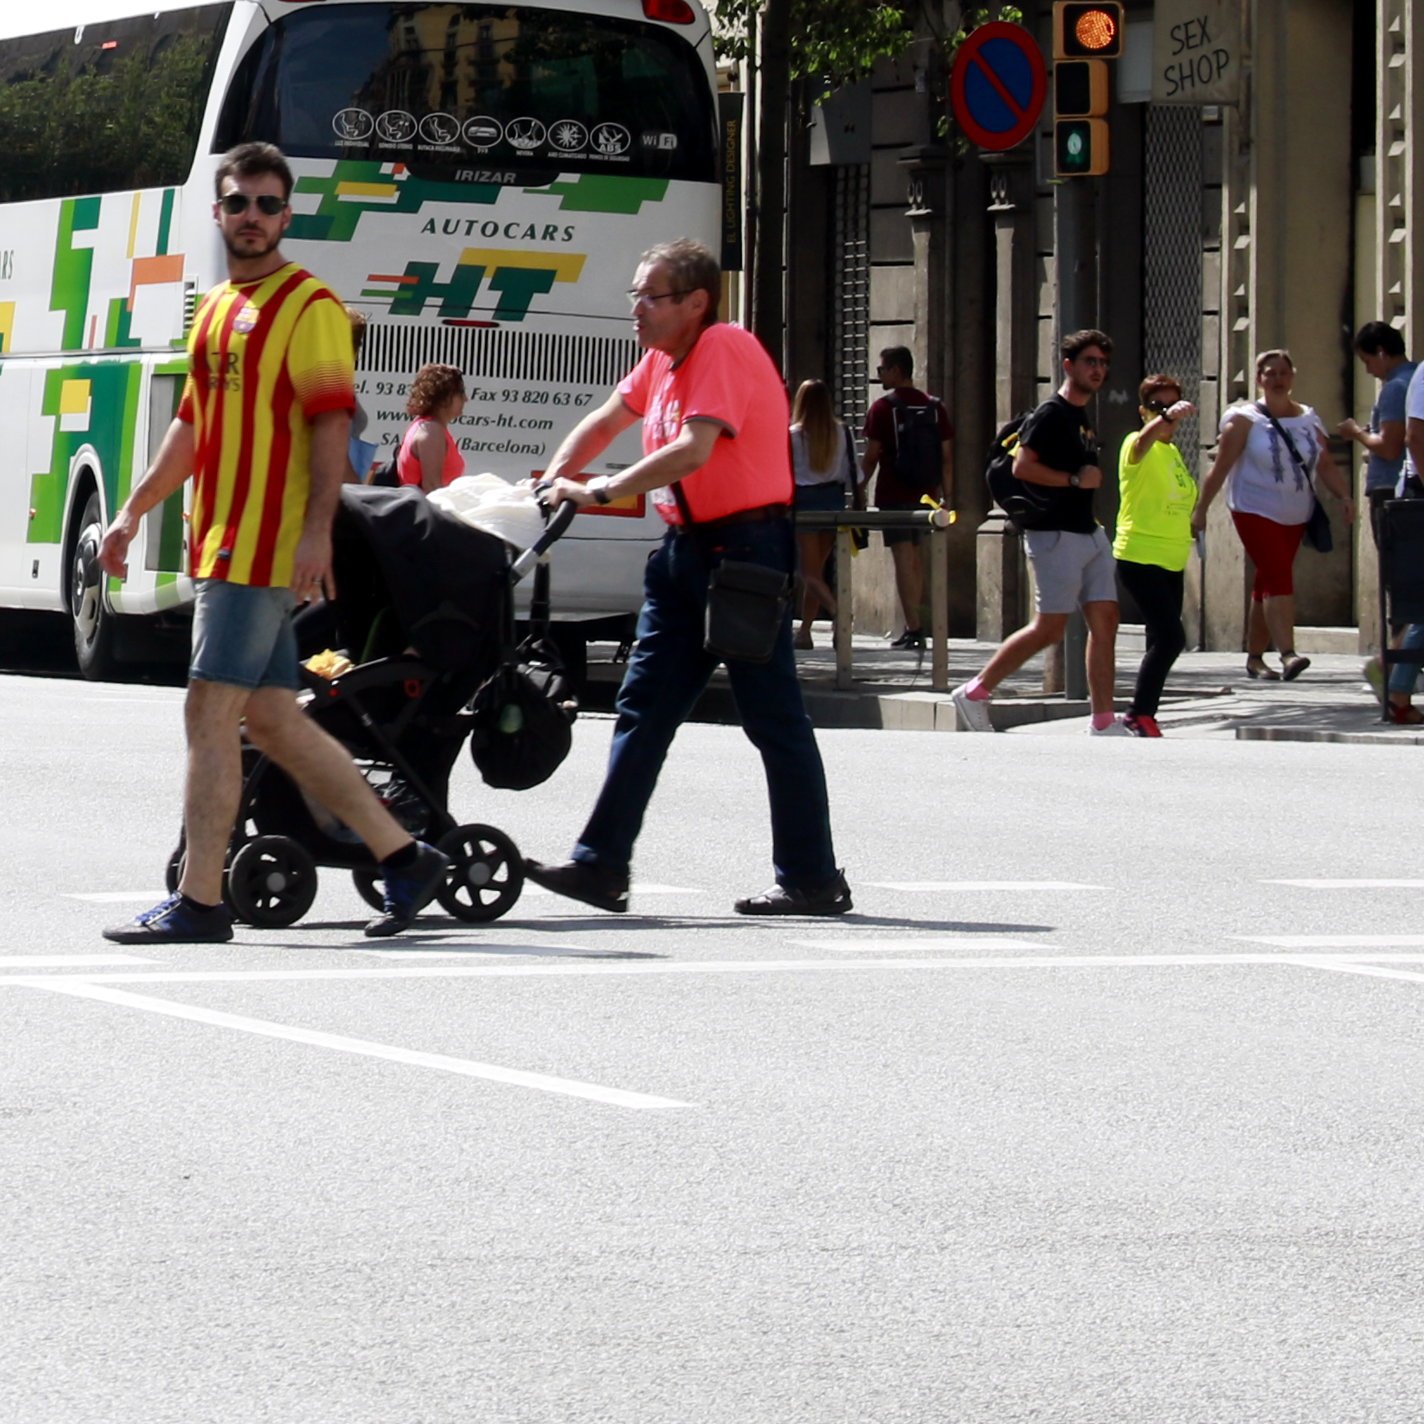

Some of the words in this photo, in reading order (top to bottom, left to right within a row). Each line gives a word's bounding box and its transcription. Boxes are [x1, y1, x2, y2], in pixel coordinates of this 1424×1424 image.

[1170, 15, 1212, 56] SEX
[1163, 48, 1230, 97] SHOP
[598, 143, 622, 153] ABS
[726, 119, 737, 172] DESIGNER
[454, 169, 517, 184] IRIZAR
[726, 178, 737, 229] LIGHTING
[420, 217, 576, 242] AUTOCARS
[387, 260, 558, 322] HT
[354, 380, 369, 394] el.
[376, 382, 393, 395] 93
[471, 387, 496, 402] Fax
[501, 390, 518, 403] 93
[523, 391, 549, 405] 820
[552, 393, 570, 406] 63
[574, 393, 593, 407] 67
[455, 436, 546, 457] (Barcelona)
